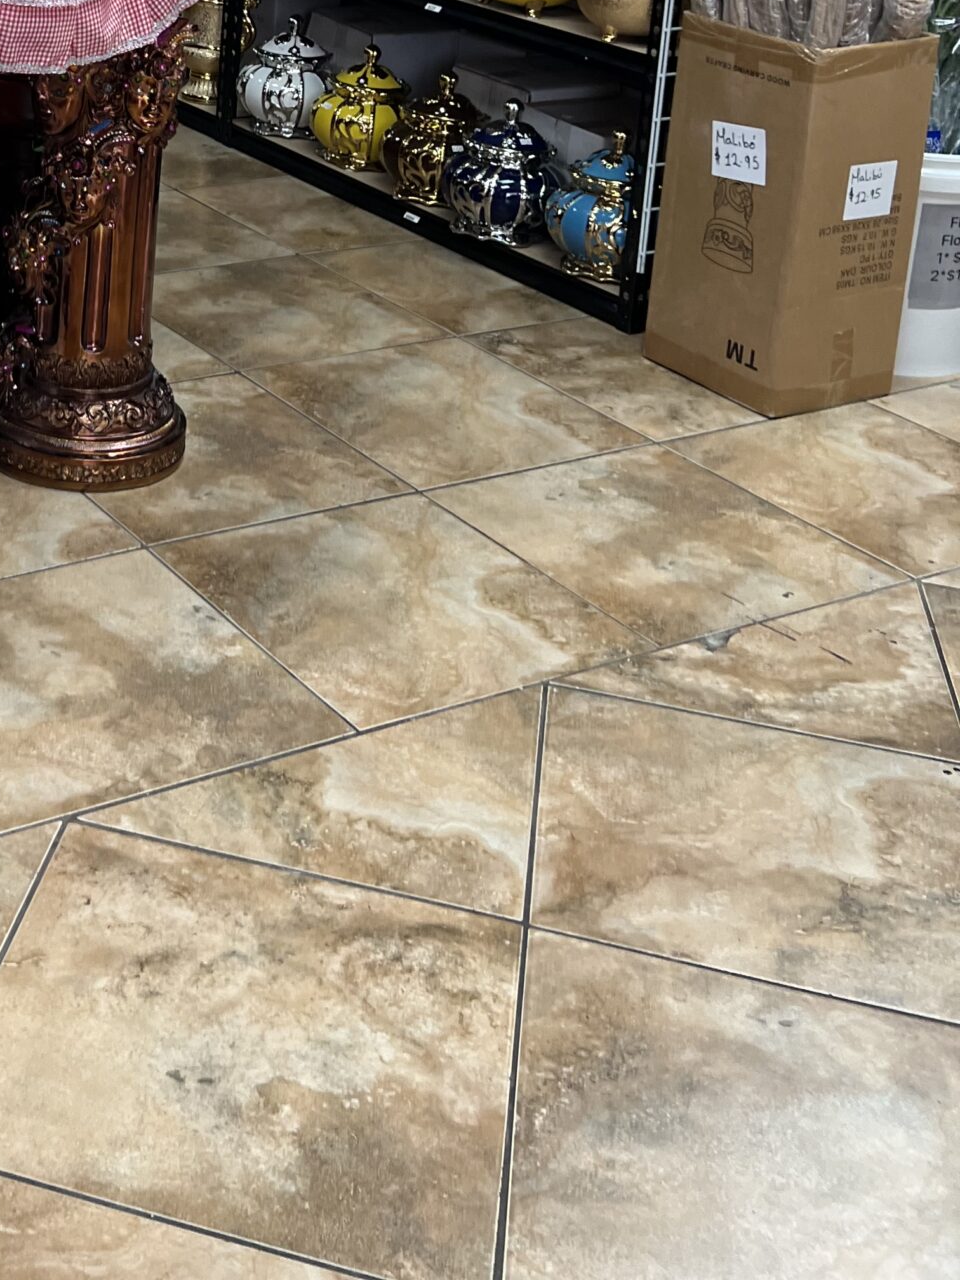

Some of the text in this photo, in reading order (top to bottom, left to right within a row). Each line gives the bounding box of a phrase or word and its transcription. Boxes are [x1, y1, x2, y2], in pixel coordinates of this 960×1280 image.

[705, 55, 791, 88] WOOD CARVING CRAFTS
[726, 339, 759, 372] TM
